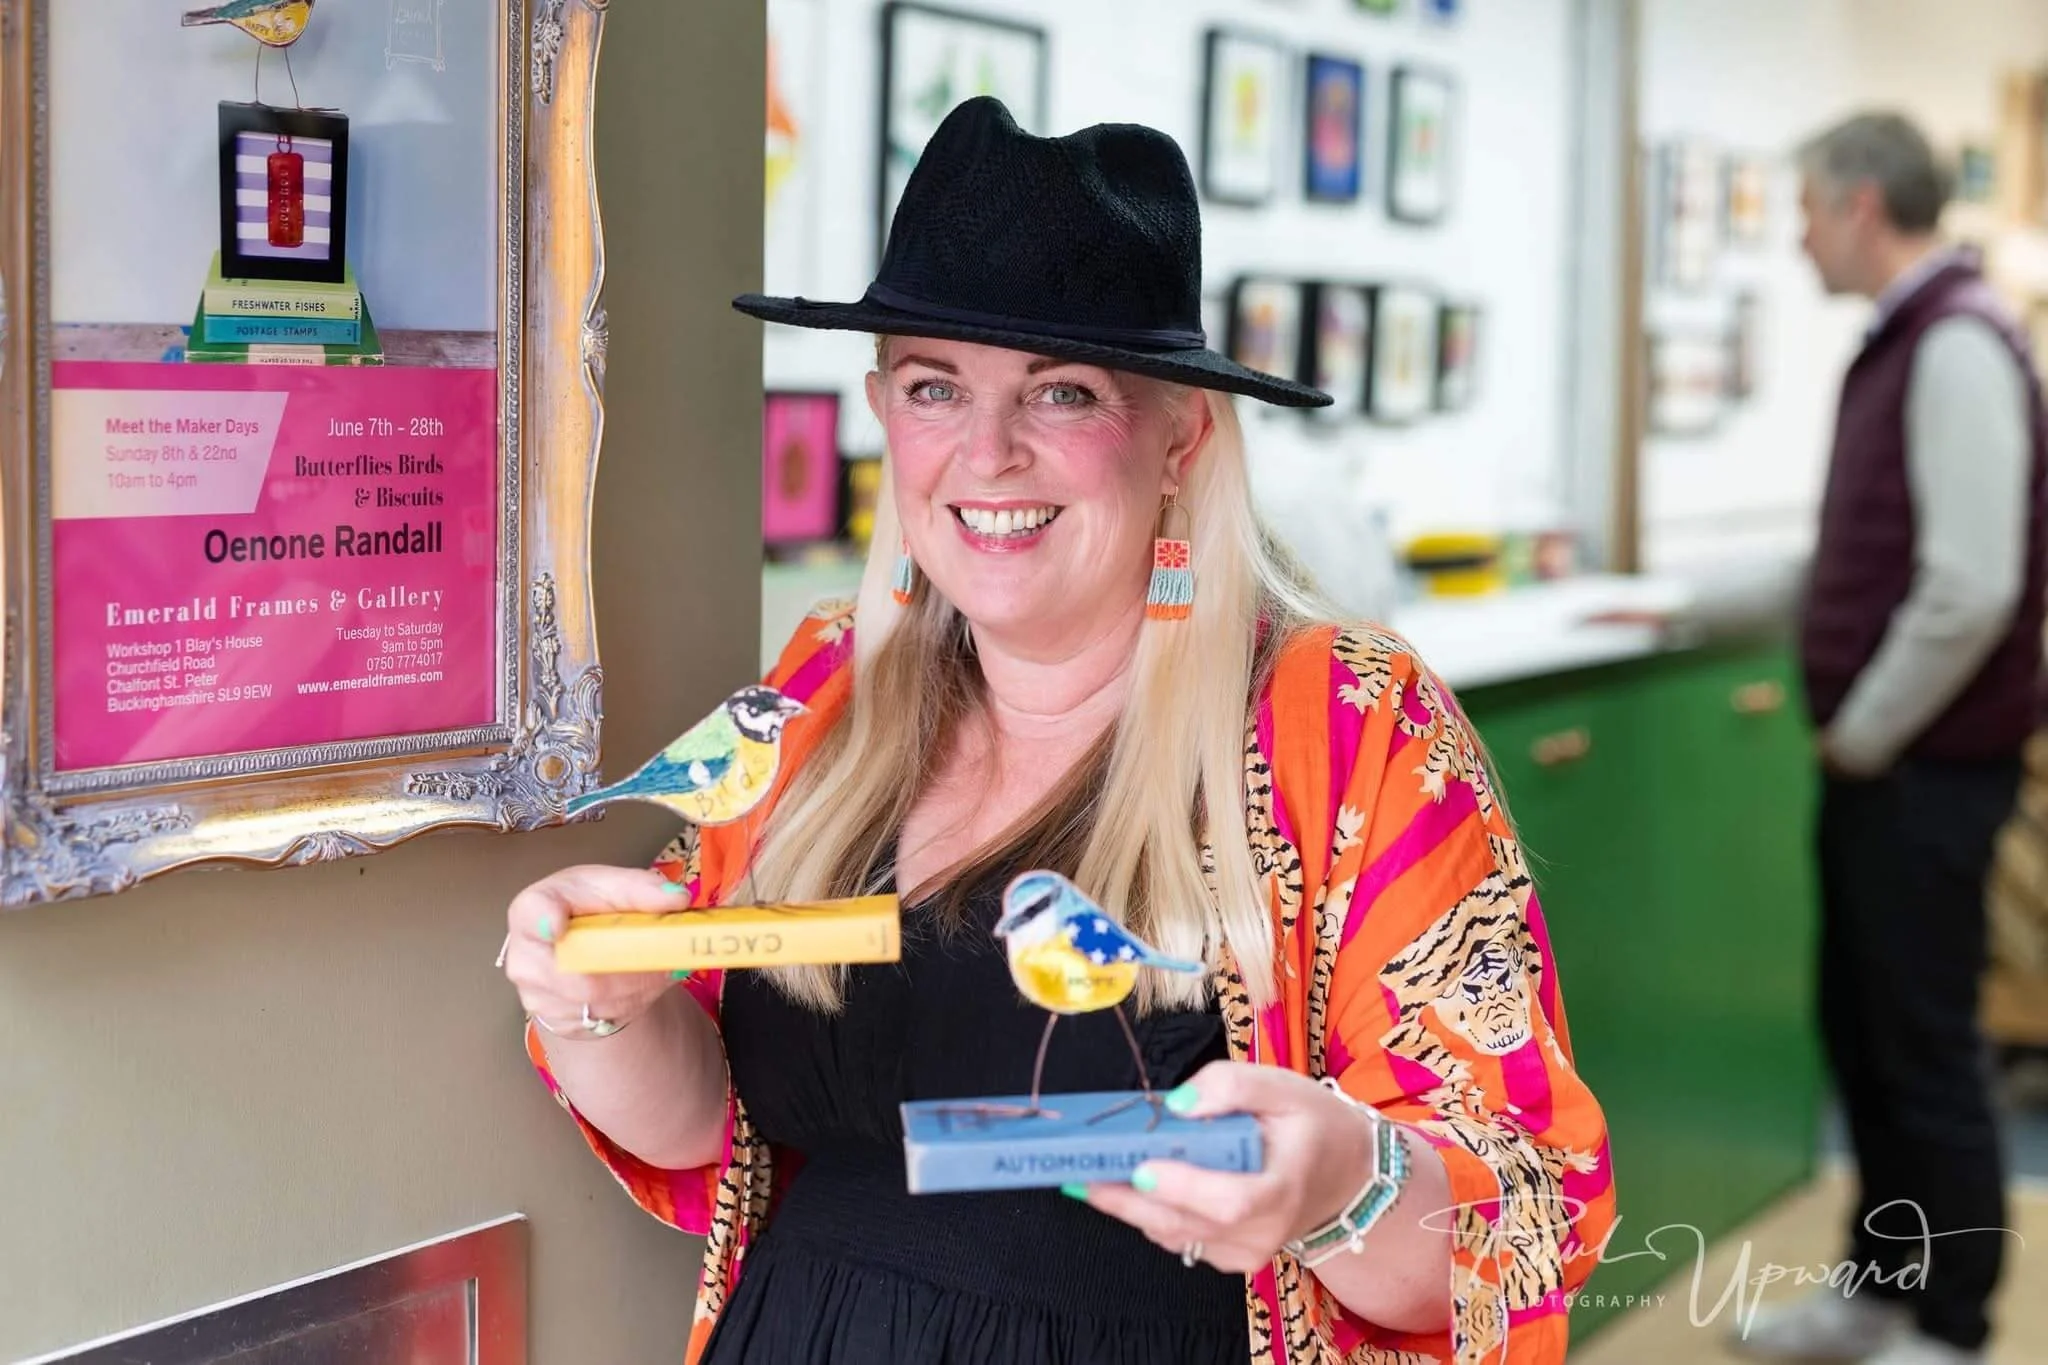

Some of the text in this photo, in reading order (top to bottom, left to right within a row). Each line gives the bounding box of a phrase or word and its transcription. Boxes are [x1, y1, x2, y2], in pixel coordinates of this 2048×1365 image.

[231, 299, 326, 313] FRESHWATER FISHES
[236, 325, 318, 337] POSTAGE STAMPS
[105, 418, 260, 437] Meet the Maker Days
[327, 417, 364, 437] June
[368, 417, 393, 437] 7th
[409, 417, 444, 437] 28th
[105, 445, 238, 464] Sunday 8th & 22nd
[295, 453, 444, 477] Butterflies Birds
[107, 472, 198, 490] 10am to 4pm
[354, 486, 444, 508] & Biscuits
[204, 521, 443, 564] Oenone Randall
[106, 584, 444, 627] Emerald Frames & Gallery
[336, 620, 444, 641] Tuesday to Saturday
[106, 635, 264, 658] Workshop 1 Blay's House
[381, 636, 444, 653] 9am to 5pm
[106, 655, 216, 676] Churchfield Road
[366, 652, 444, 672] 0750 7774017
[106, 673, 219, 694] Chalfont St. Peter
[297, 669, 444, 695] www.emeraldframes.com
[106, 683, 273, 713] Buckinghamshire SL9 9EW
[690, 932, 784, 957] CACTI
